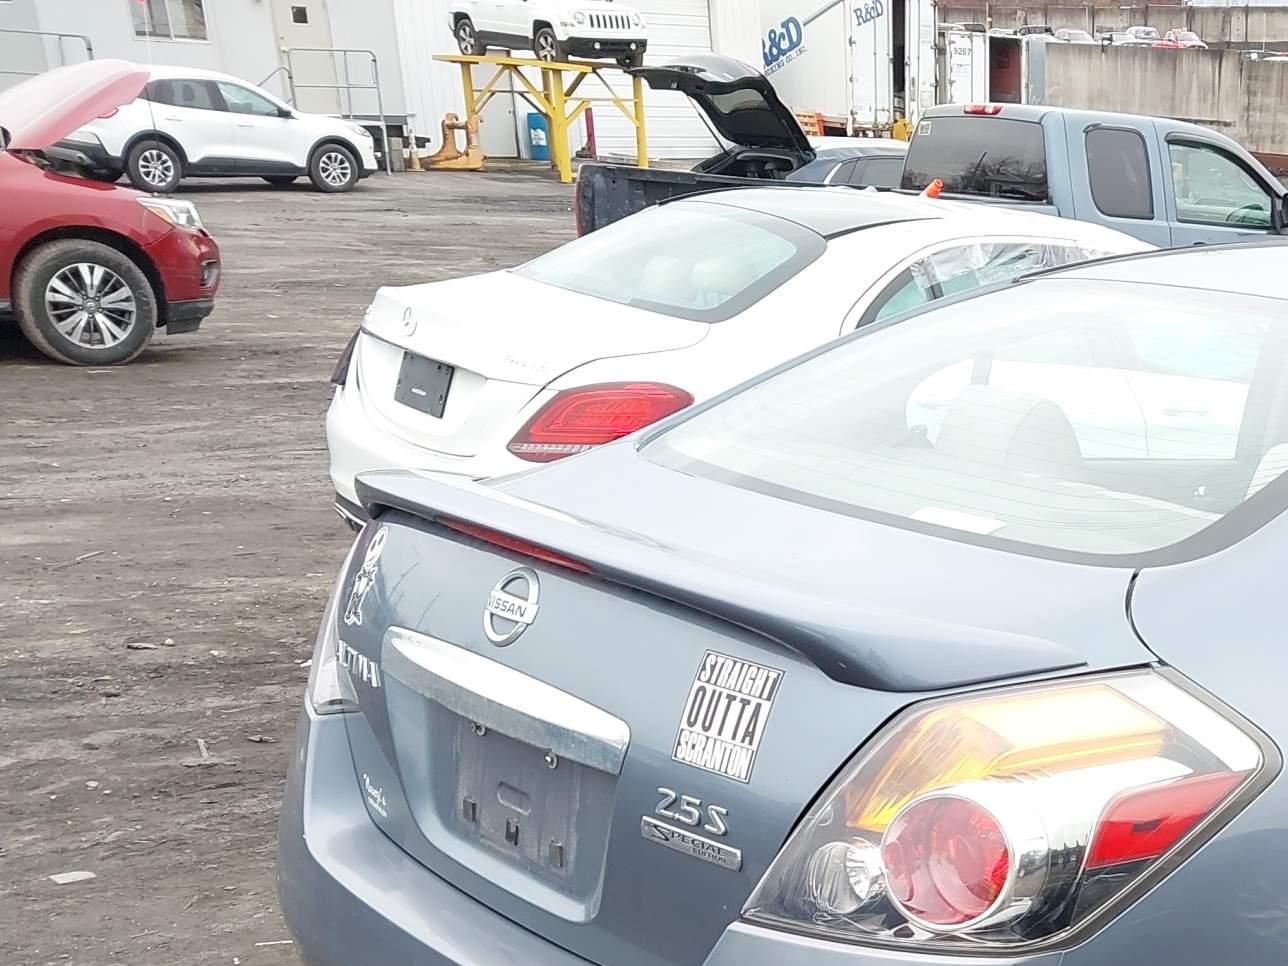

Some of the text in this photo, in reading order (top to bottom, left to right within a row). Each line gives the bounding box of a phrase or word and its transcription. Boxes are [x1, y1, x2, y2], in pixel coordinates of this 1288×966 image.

[853, 0, 884, 26] R&D
[699, 653, 779, 700] STRAIGHT
[686, 685, 763, 747] OUTTA
[676, 728, 755, 780] SCRANTON
